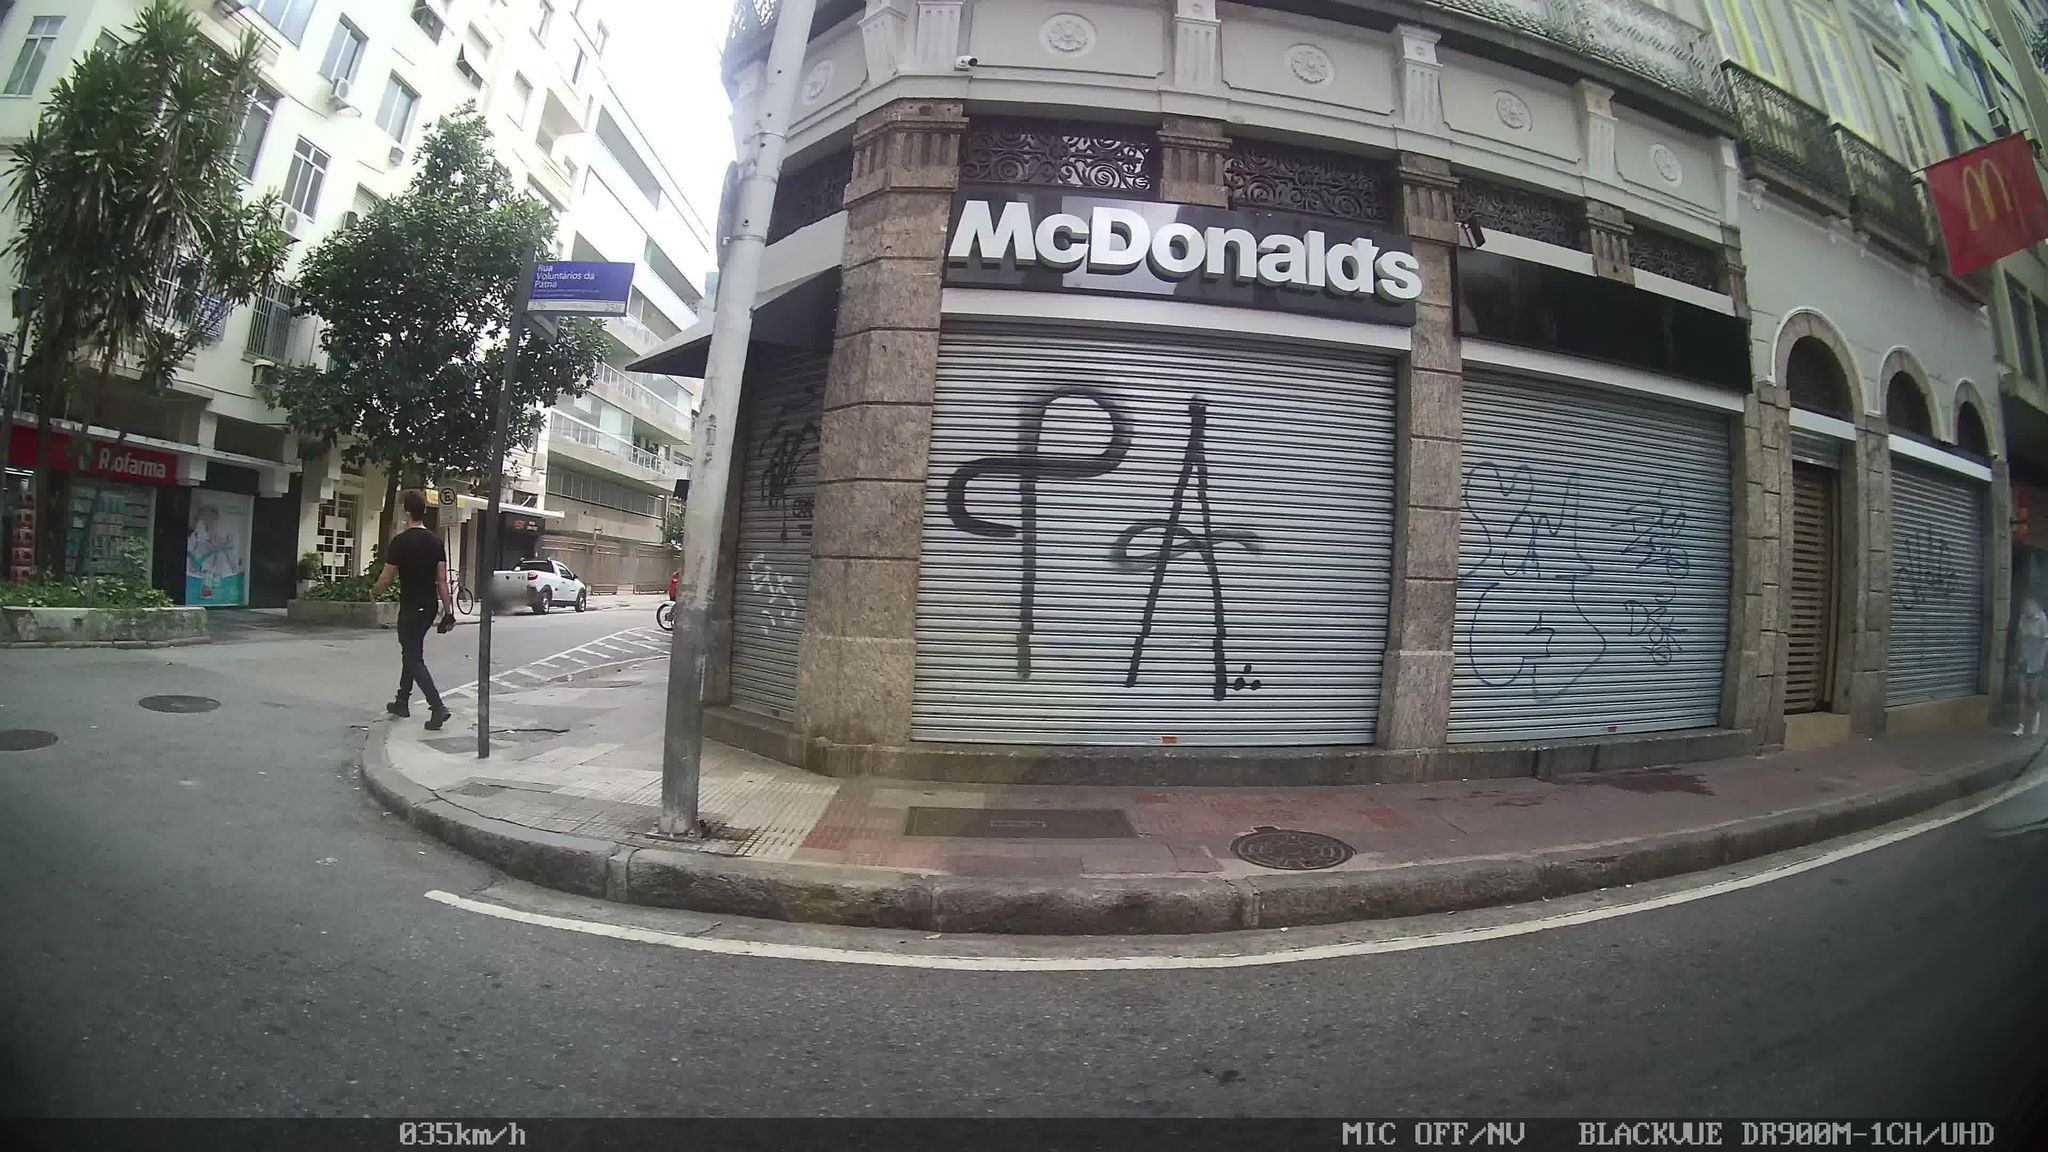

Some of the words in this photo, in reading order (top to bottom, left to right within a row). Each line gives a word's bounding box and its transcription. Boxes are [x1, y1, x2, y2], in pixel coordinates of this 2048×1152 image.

[948, 200, 1423, 302] McDonald's
[537, 264, 553, 272] Rua
[583, 271, 595, 280] da
